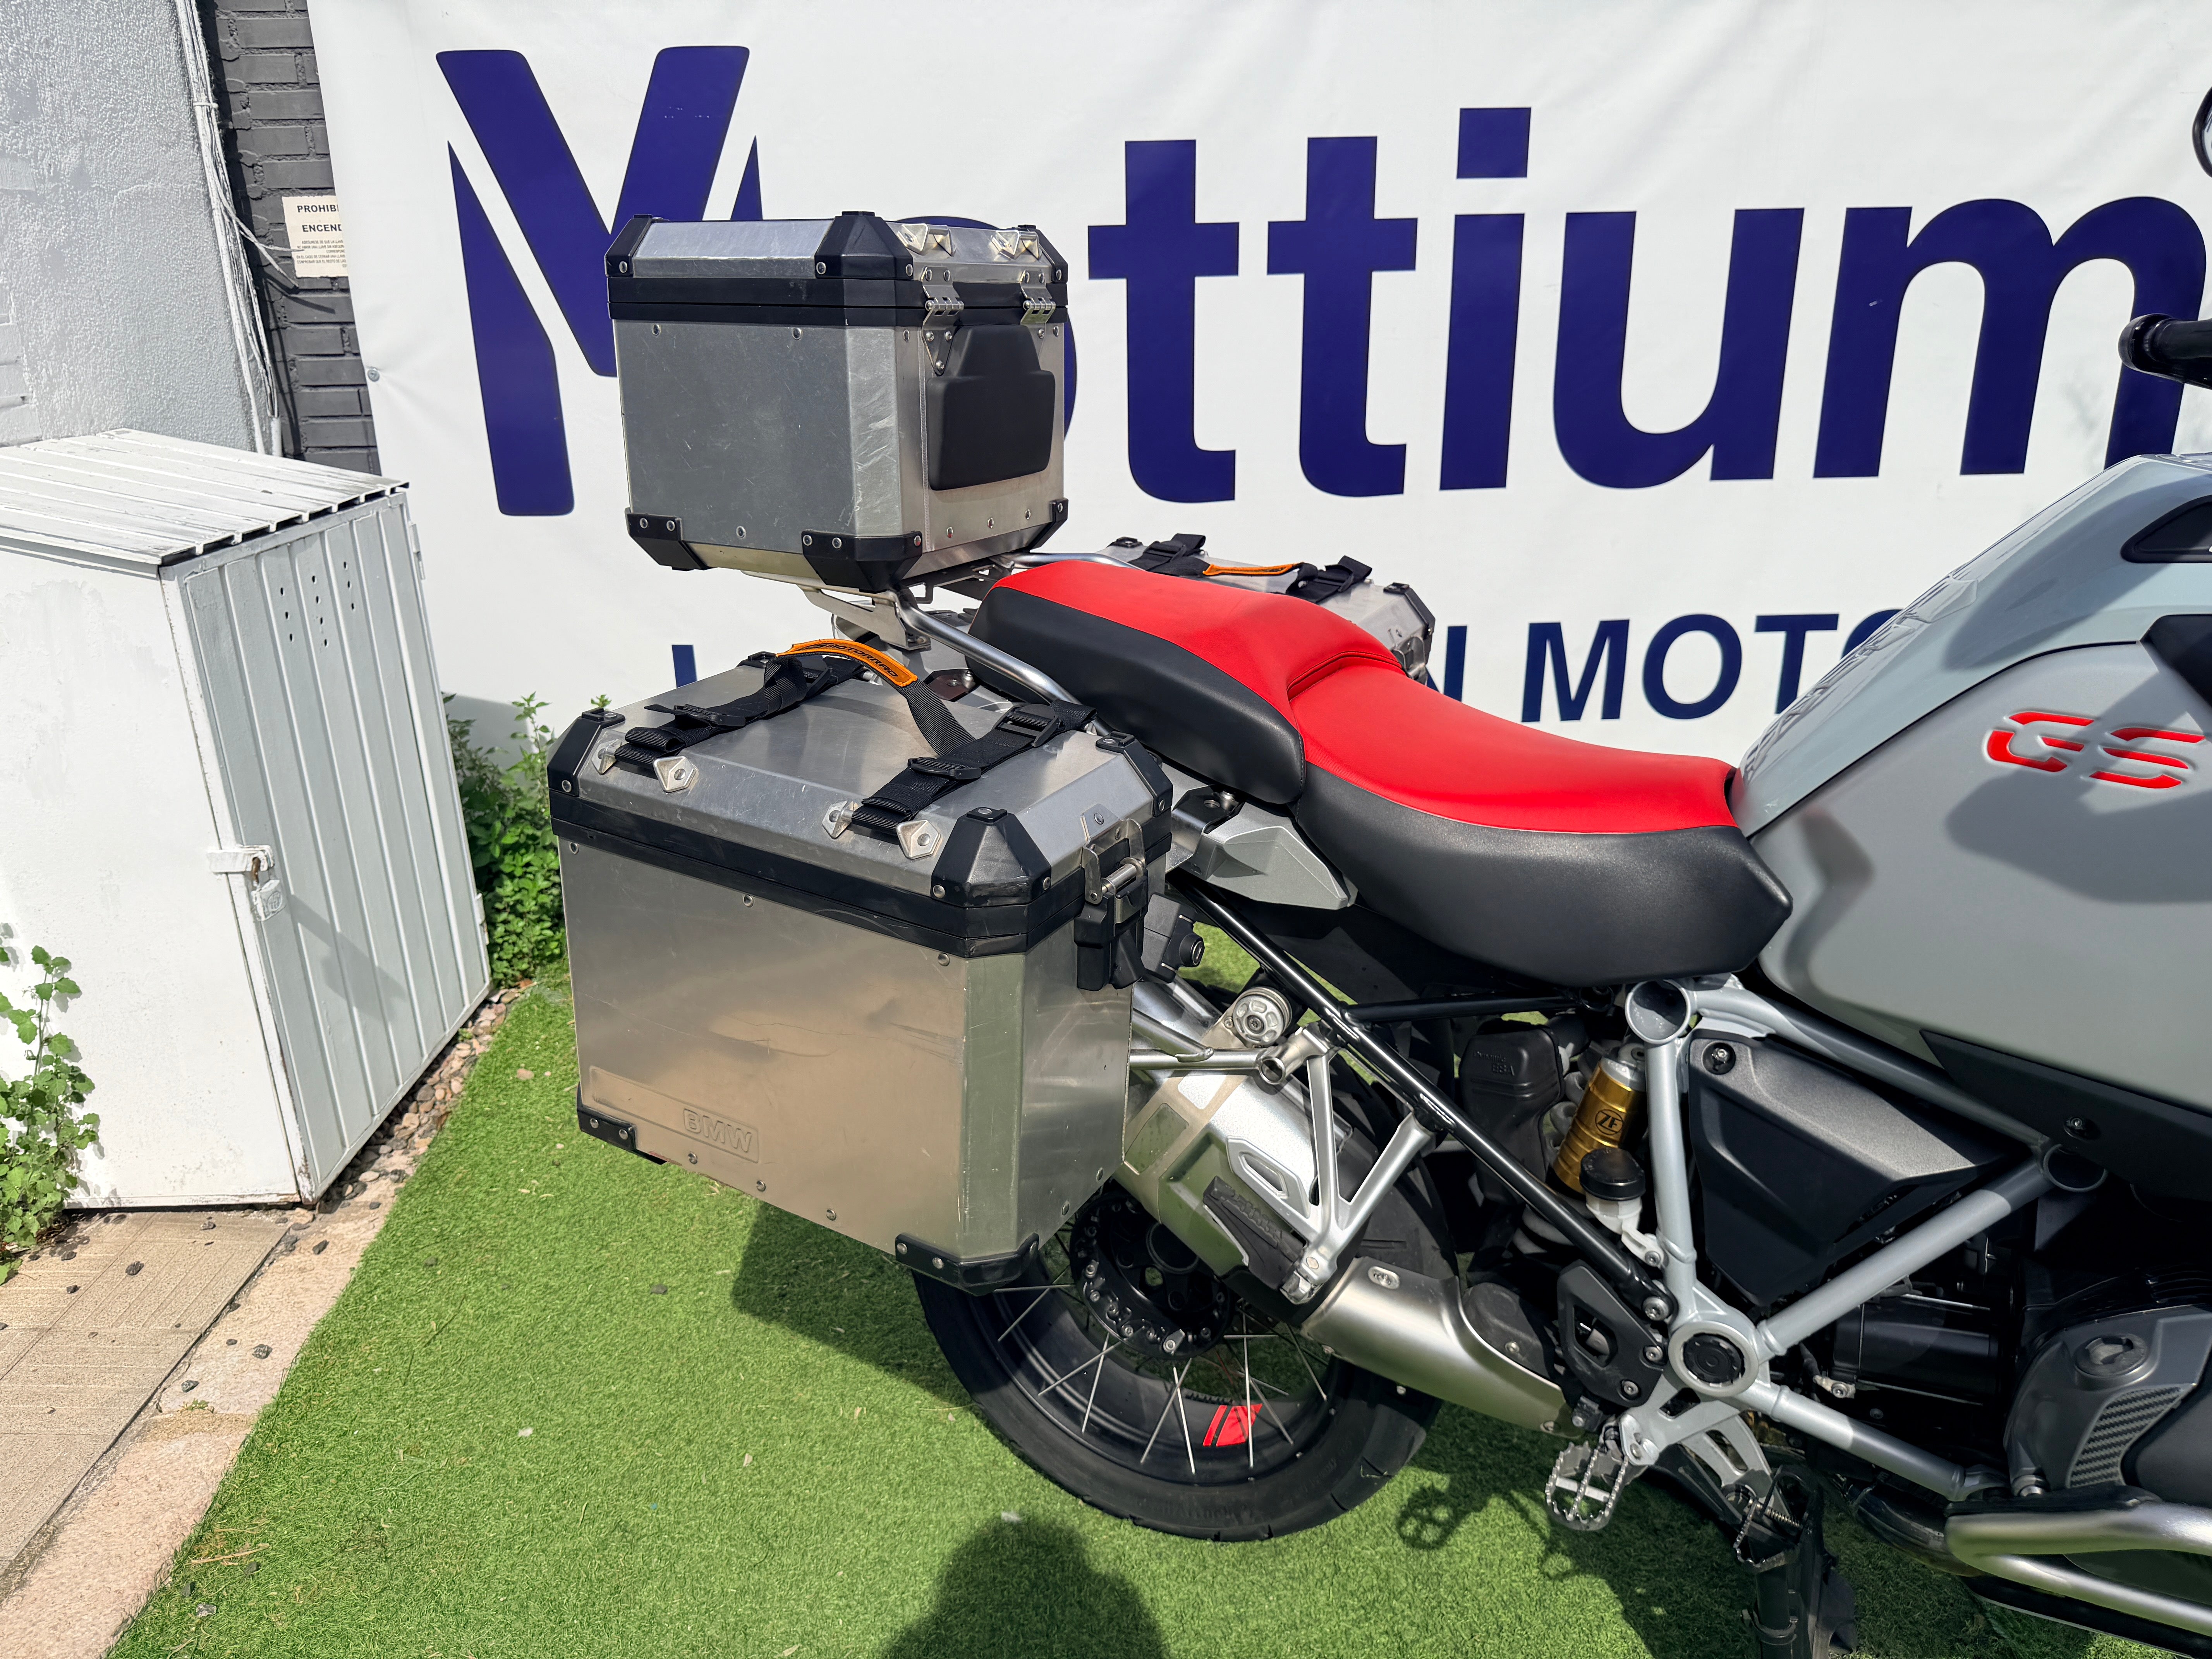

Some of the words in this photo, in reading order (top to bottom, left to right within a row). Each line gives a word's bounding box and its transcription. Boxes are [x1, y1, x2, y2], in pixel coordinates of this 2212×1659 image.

[436, 46, 2207, 516] Mttium
[1987, 711, 2206, 789] GS
[684, 1108, 752, 1153] BMW
[1599, 1113, 1623, 1129] ZF
